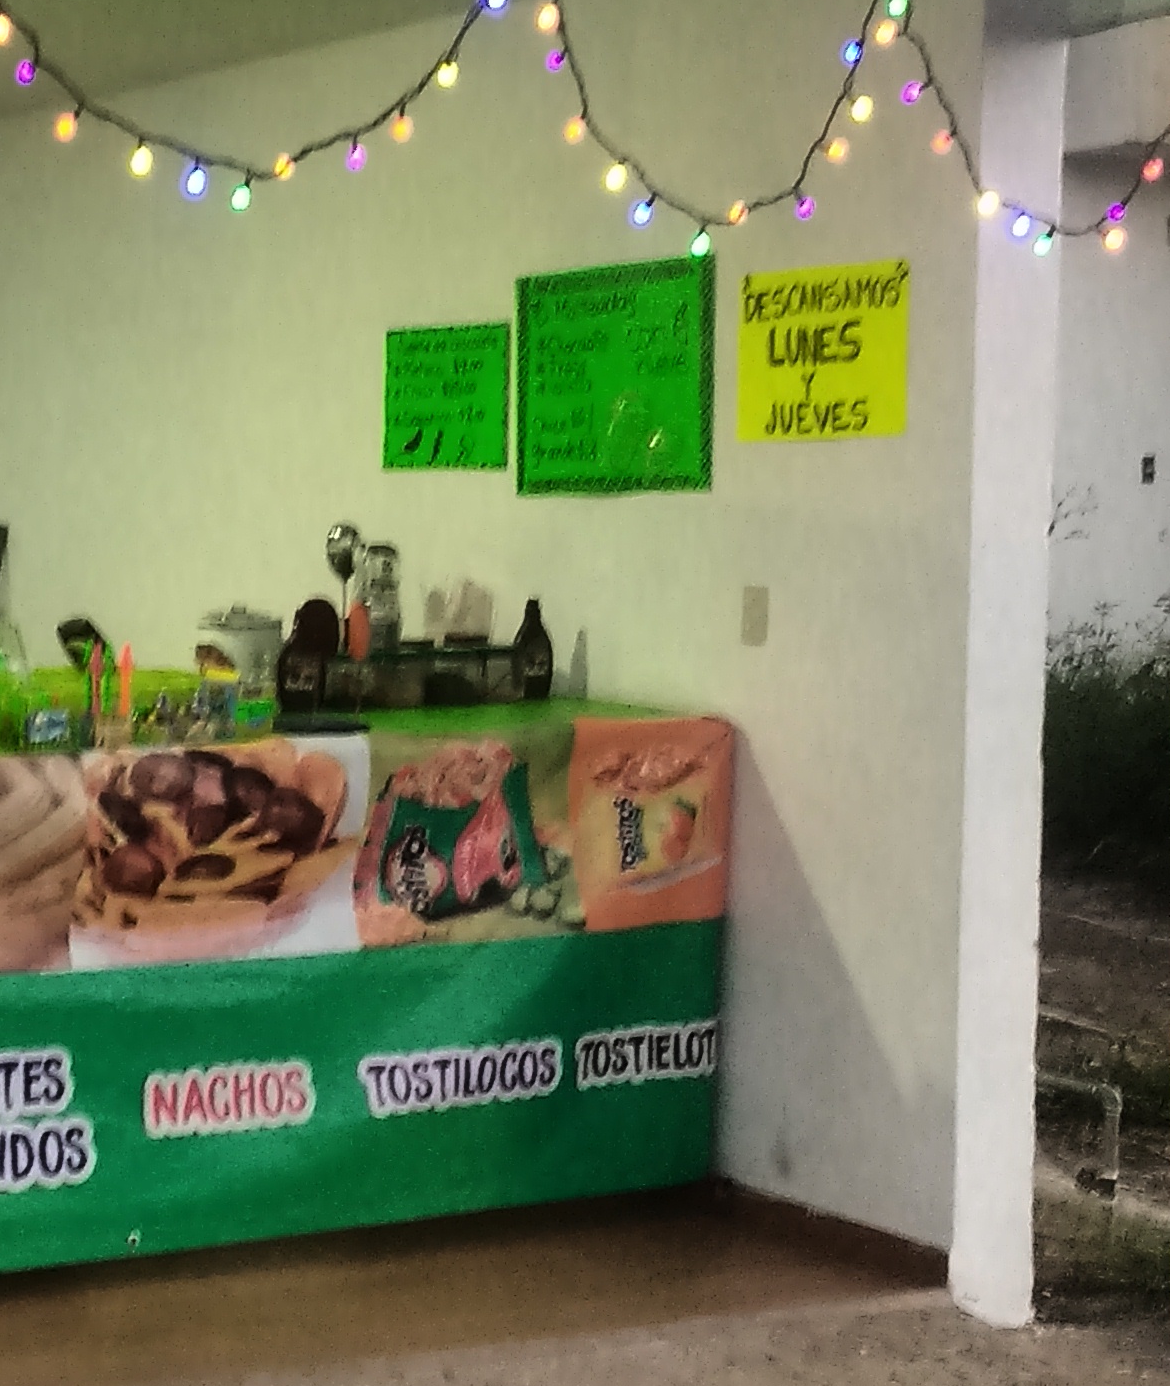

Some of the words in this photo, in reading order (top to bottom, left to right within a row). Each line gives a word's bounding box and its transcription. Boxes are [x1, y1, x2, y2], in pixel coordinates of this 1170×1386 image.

[768, 319, 862, 367] LUNES
[800, 369, 816, 401] Y
[765, 398, 869, 435] JUEVES
[149, 1068, 308, 1127] NACHOS
[366, 1047, 557, 1109] TOSTILOCOS
